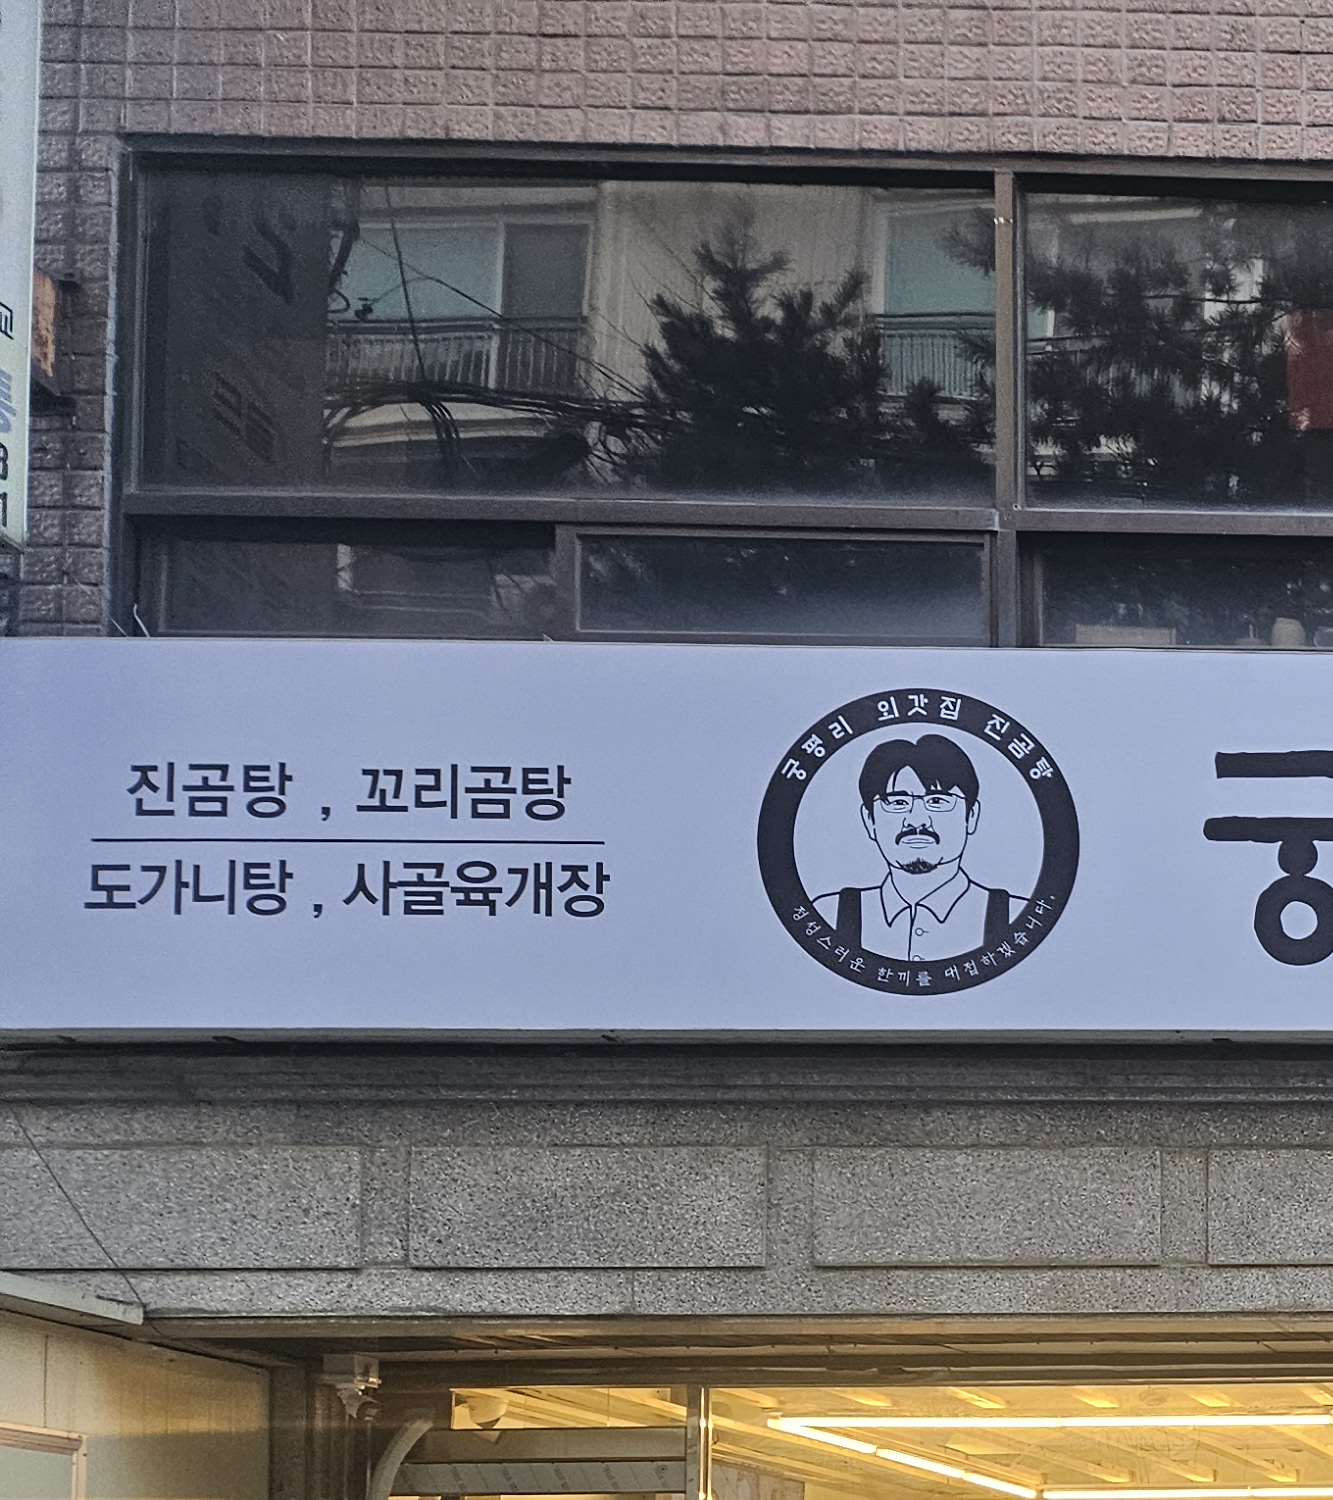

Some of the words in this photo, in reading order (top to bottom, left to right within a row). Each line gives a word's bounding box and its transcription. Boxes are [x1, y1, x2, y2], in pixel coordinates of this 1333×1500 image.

[782, 715, 854, 781] 궁평리
[876, 694, 963, 721] 외갓집
[986, 714, 1055, 781] 진곰탕
[126, 762, 293, 819] 진곰탕
[356, 764, 571, 821] 꼬리곰탕
[84, 859, 293, 917] 도가니탕
[342, 861, 610, 918] 사골육개장
